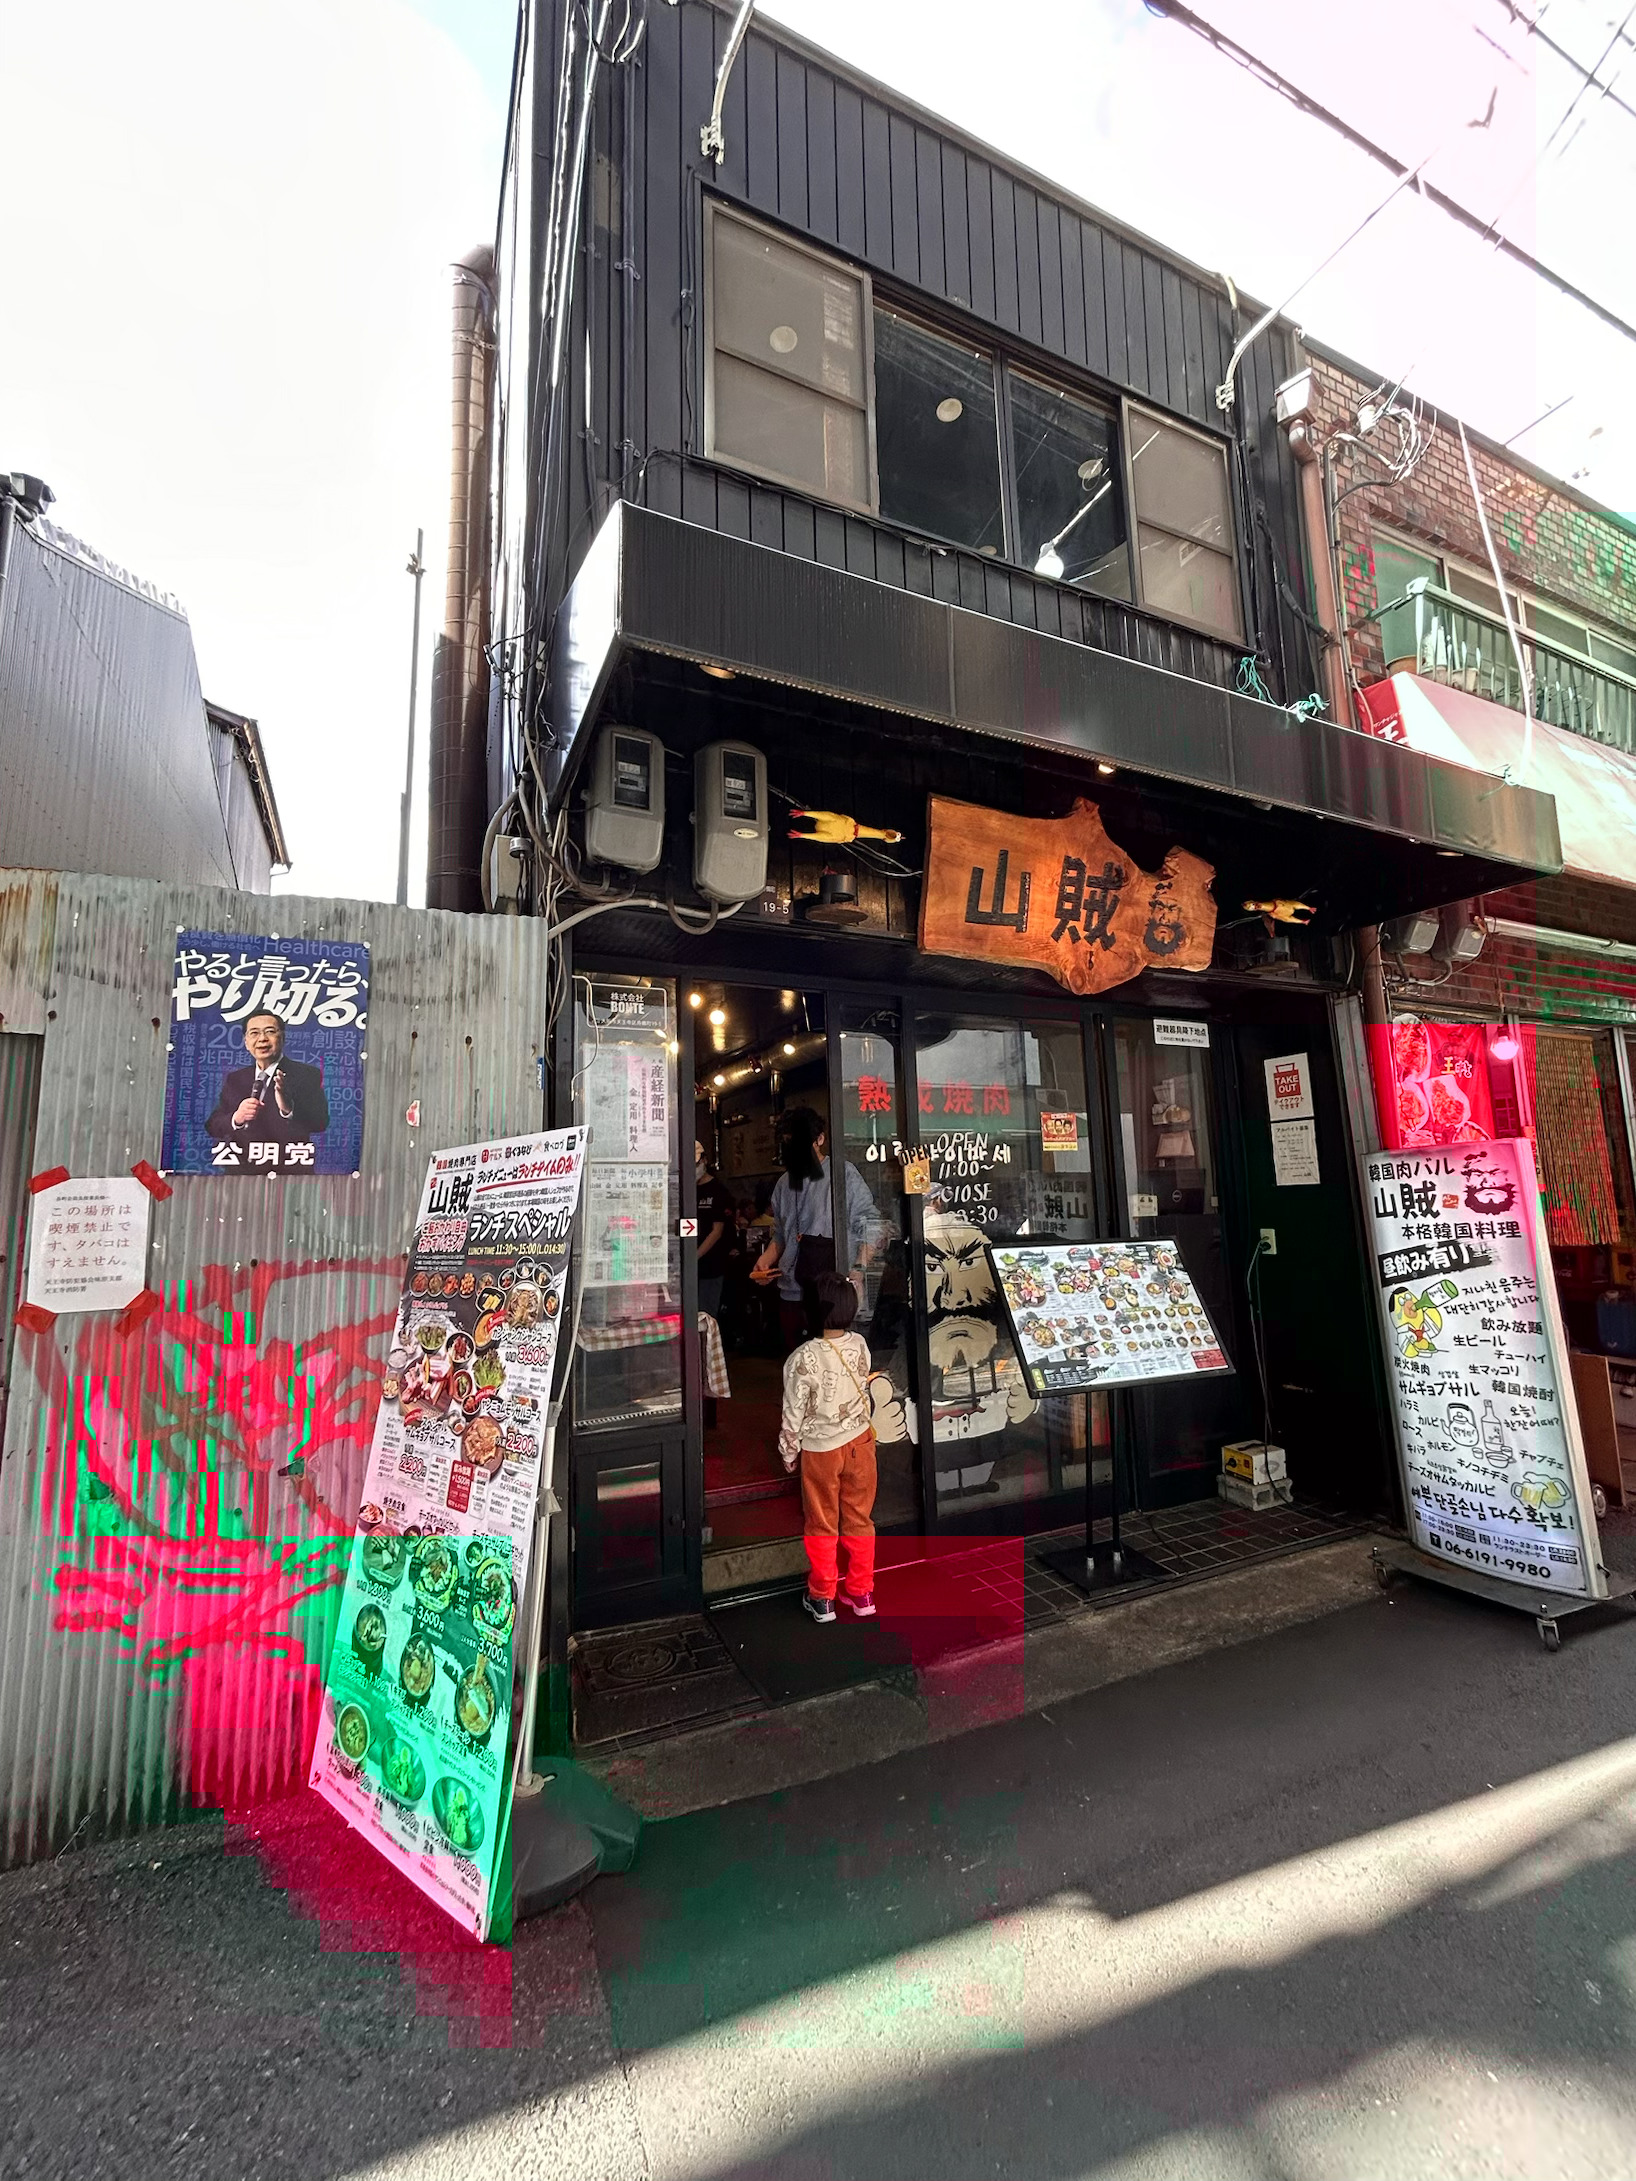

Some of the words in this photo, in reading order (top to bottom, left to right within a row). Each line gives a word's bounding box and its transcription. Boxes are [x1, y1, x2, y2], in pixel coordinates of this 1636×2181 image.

[763, 901, 789, 914] 19-5
[965, 849, 1126, 952] 山賊
[264, 937, 370, 959] Healthcare
[175, 949, 369, 989] やると言ったら、
[172, 975, 367, 1030] やり切る。
[610, 992, 644, 1004] 株式会社
[312, 1029, 357, 1051] 創設
[1275, 1074, 1299, 1085] TAKE
[1278, 1084, 1297, 1093] OUT
[651, 1065, 665, 1122] 産経新聞
[937, 1132, 989, 1153] OPEN
[211, 1141, 315, 1166] 公明党
[1369, 1157, 1455, 1182] 韓国肉バル
[428, 1172, 474, 1214] 山賊
[1374, 1180, 1441, 1219] 山賊
[52, 1204, 132, 1217] この場所は
[48, 1221, 131, 1235] 喫煙禁止で
[1402, 1221, 1522, 1240] 本格韓国料理
[47, 1238, 130, 1252] す、タバコは
[46, 1255, 127, 1269] すえません。
[1382, 1243, 1470, 1278] 昼飲み有り
[1481, 1317, 1543, 1335] 飲み放題
[1453, 1335, 1506, 1347] 生ビール
[1394, 1356, 1430, 1375] 炭火焼肉
[1494, 1350, 1546, 1364] チューハイ
[1468, 1364, 1520, 1376] 生マッコリ
[1492, 1379, 1555, 1402] 韓国焼酎
[1400, 1398, 1420, 1412] ハラミ
[1402, 1420, 1424, 1438] ロース
[1418, 1415, 1439, 1427] カルビ
[1427, 1441, 1456, 1452] ホルモン
[1444, 1541, 1551, 1579] 06-6191-9980
